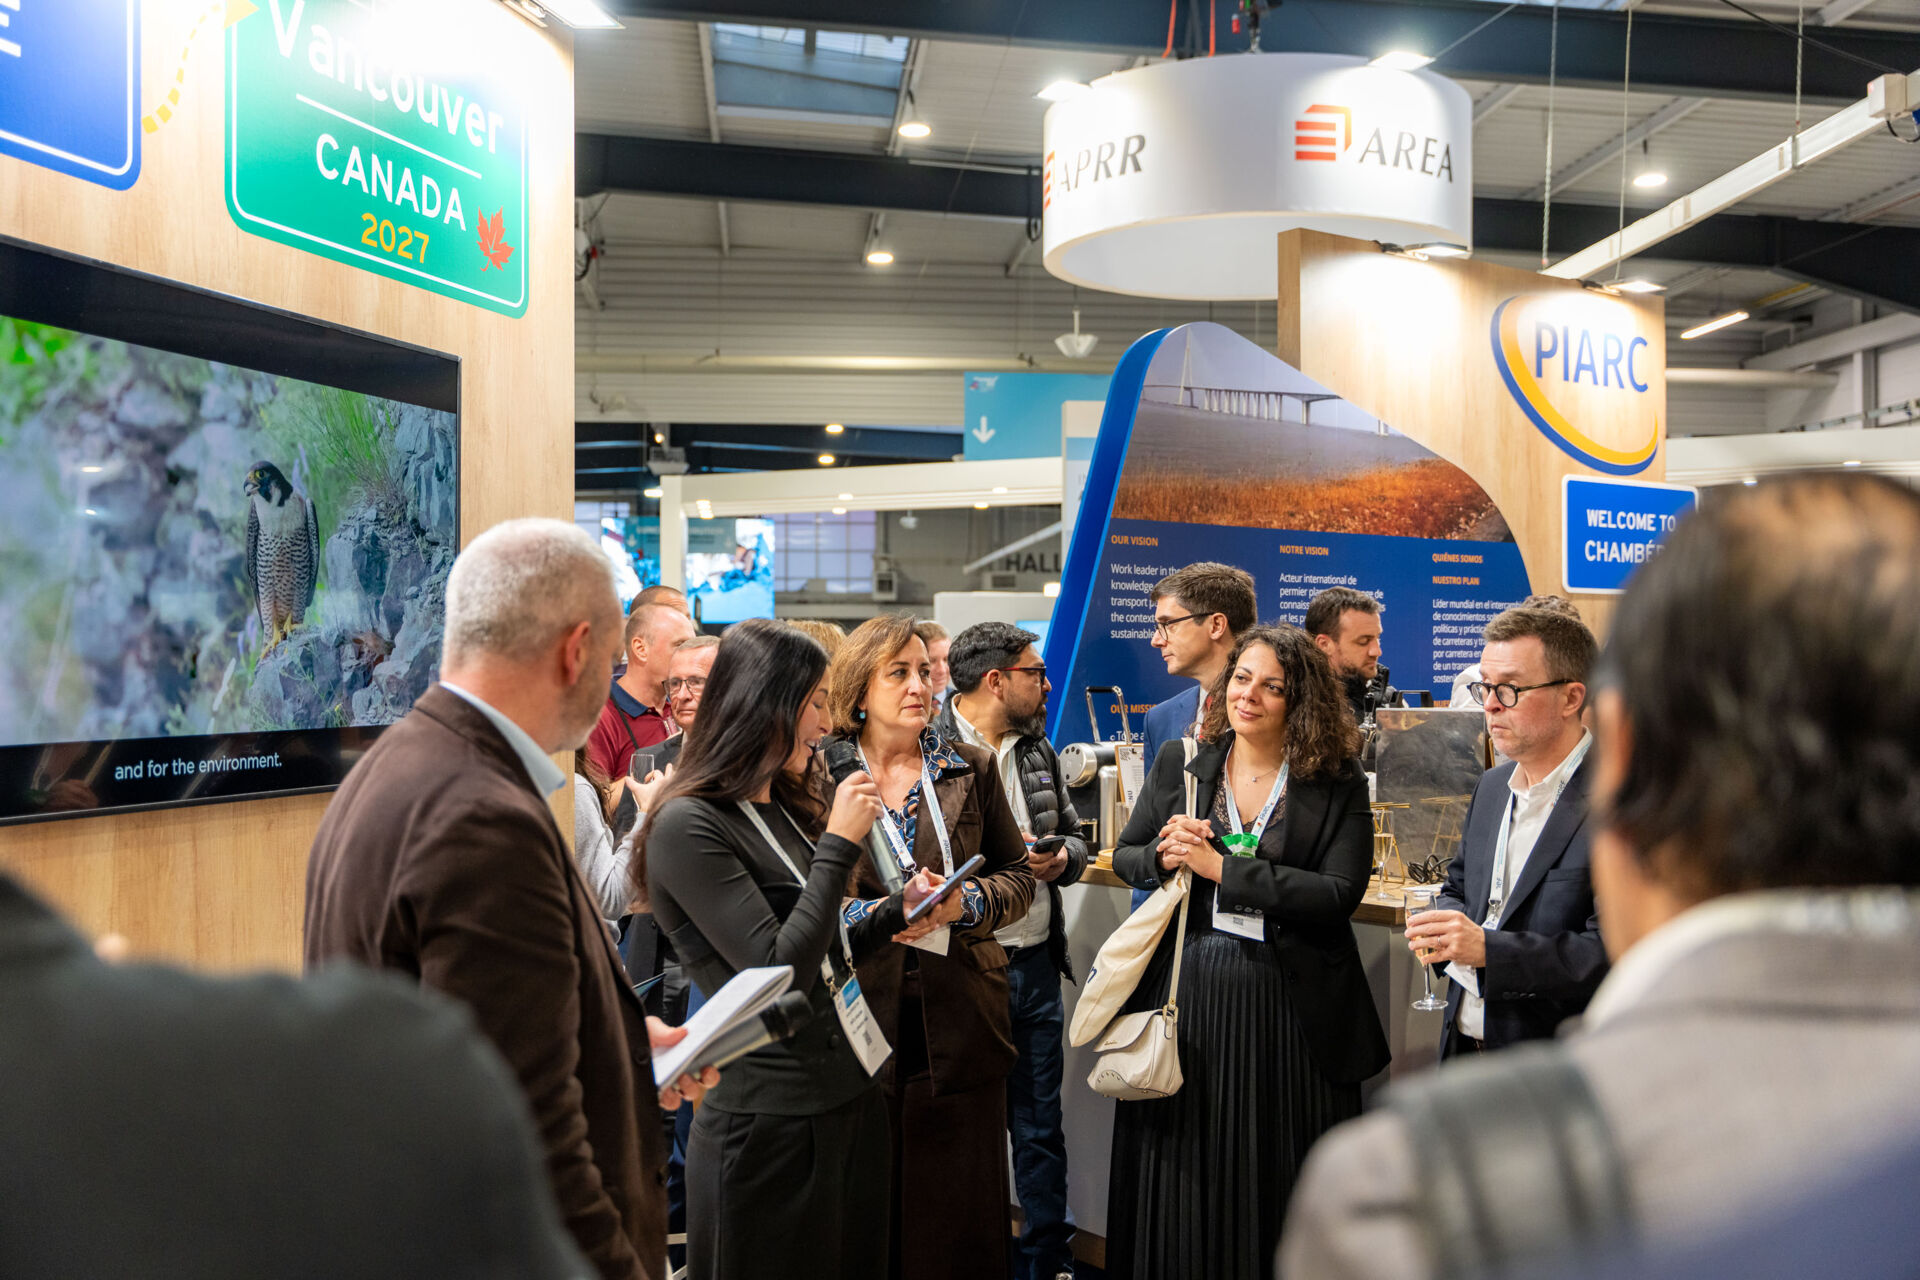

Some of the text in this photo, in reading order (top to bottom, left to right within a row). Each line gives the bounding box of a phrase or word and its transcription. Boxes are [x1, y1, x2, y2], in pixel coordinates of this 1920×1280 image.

[269, 0, 505, 155] Vancouver
[1358, 127, 1454, 184] AREA
[1059, 133, 1147, 193] APRR
[315, 132, 467, 232] CANADA
[360, 212, 431, 264] 2027
[1535, 321, 1648, 393] PIARC
[1586, 508, 1677, 533] WELCOME TO
[1111, 534, 1159, 547] OUR VISION
[1280, 545, 1329, 556] NOTRE VISION
[1584, 539, 1665, 564] CHAMBÉ
[1006, 552, 1061, 574] HALL
[1460, 554, 1483, 564] SOMOS
[1110, 563, 1133, 575] Work
[1133, 564, 1158, 576] leader
[1159, 565, 1168, 576] in
[1279, 573, 1357, 585] Acteur international de
[1432, 576, 1480, 586] NUESTRO PLAN
[1110, 579, 1154, 594] knowledge
[1279, 586, 1307, 598] permier
[1110, 597, 1148, 609] transport
[1279, 601, 1310, 611] connaiss
[1449, 599, 1475, 610] mundial
[1475, 601, 1484, 610] en
[1110, 611, 1155, 623] the context
[1288, 613, 1299, 623] les
[1432, 611, 1441, 621] de
[1441, 612, 1486, 622] conocimientos
[1432, 637, 1441, 646] de
[1441, 638, 1473, 647] carreteras
[1433, 651, 1444, 661] por
[1444, 650, 1473, 659] carretera
[1432, 662, 1441, 672] de
[1442, 663, 1451, 671] un
[115, 752, 282, 780] and for the environment.
